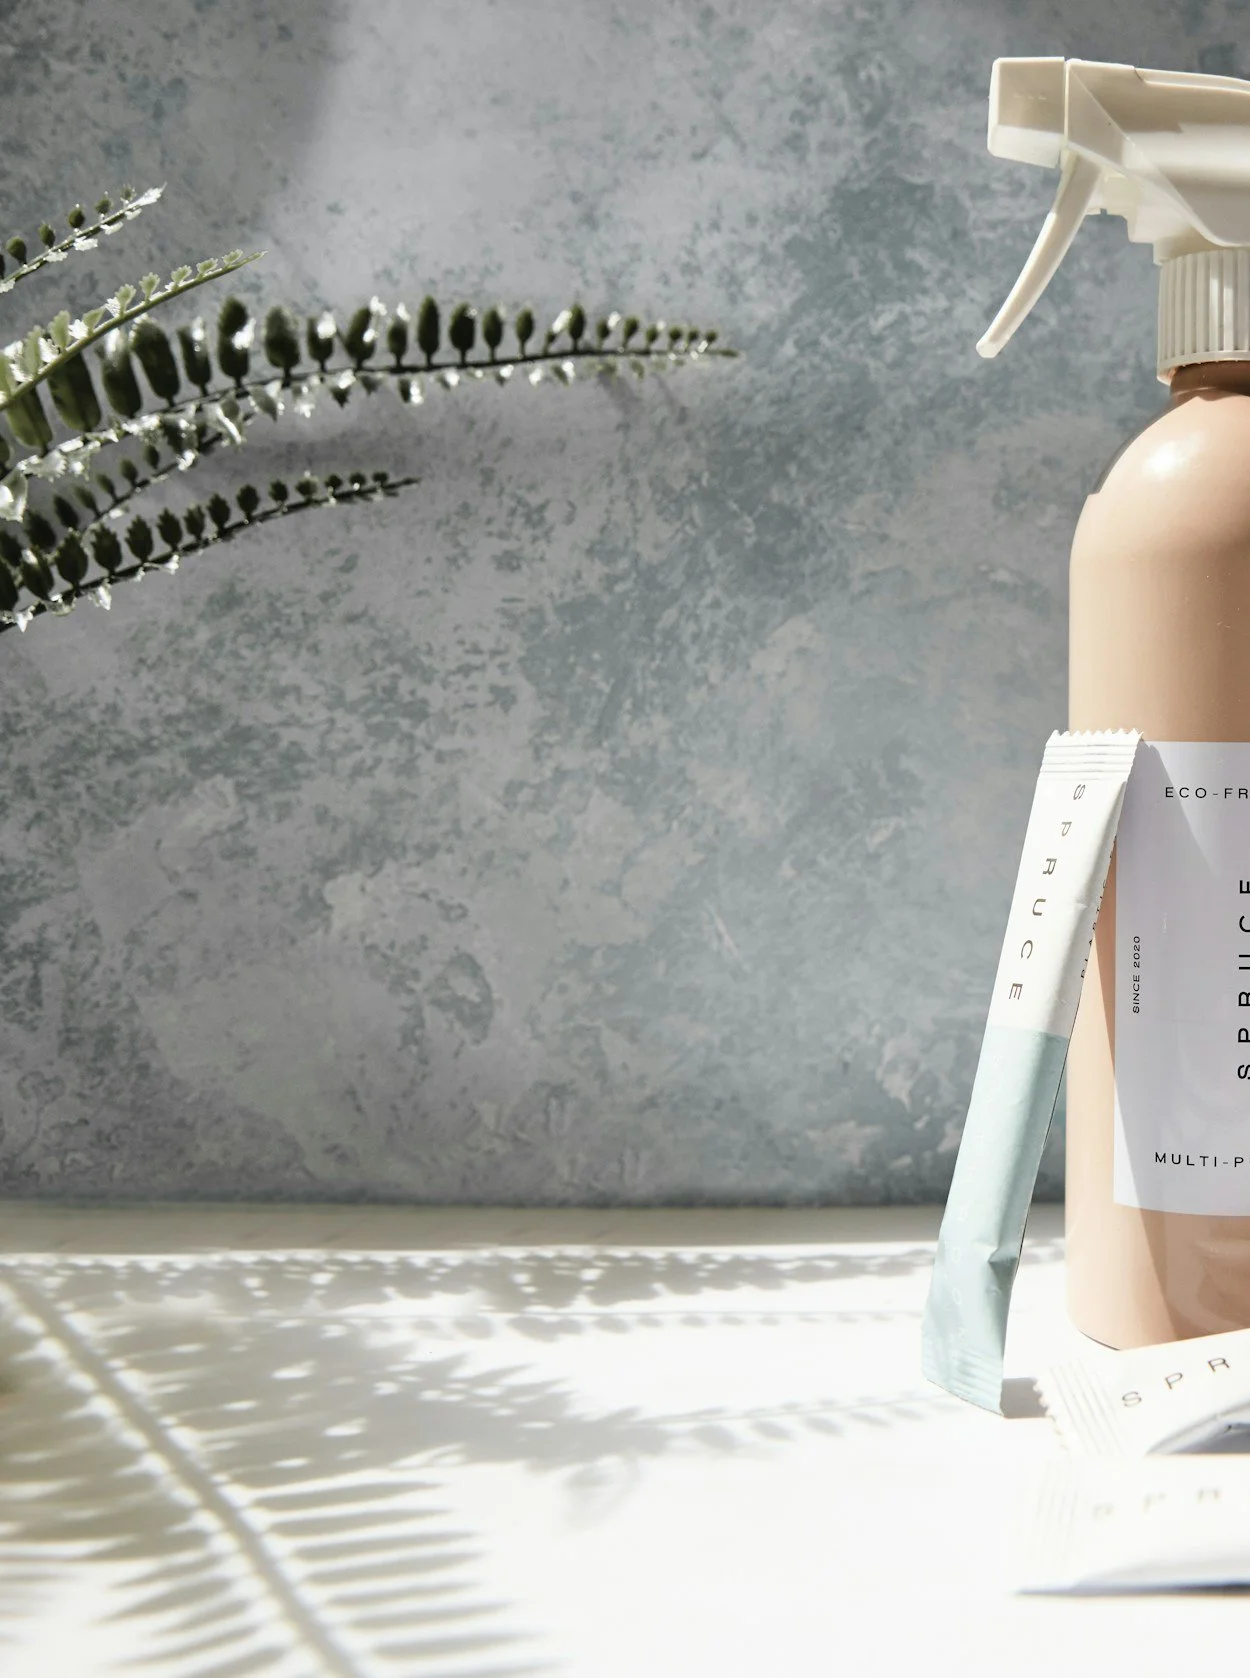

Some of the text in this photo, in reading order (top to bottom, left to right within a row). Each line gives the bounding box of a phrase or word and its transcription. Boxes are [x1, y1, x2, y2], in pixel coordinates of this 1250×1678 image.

[1008, 783, 1086, 1001] SPRUCE
[1132, 935, 1142, 1014] SINCE 2020
